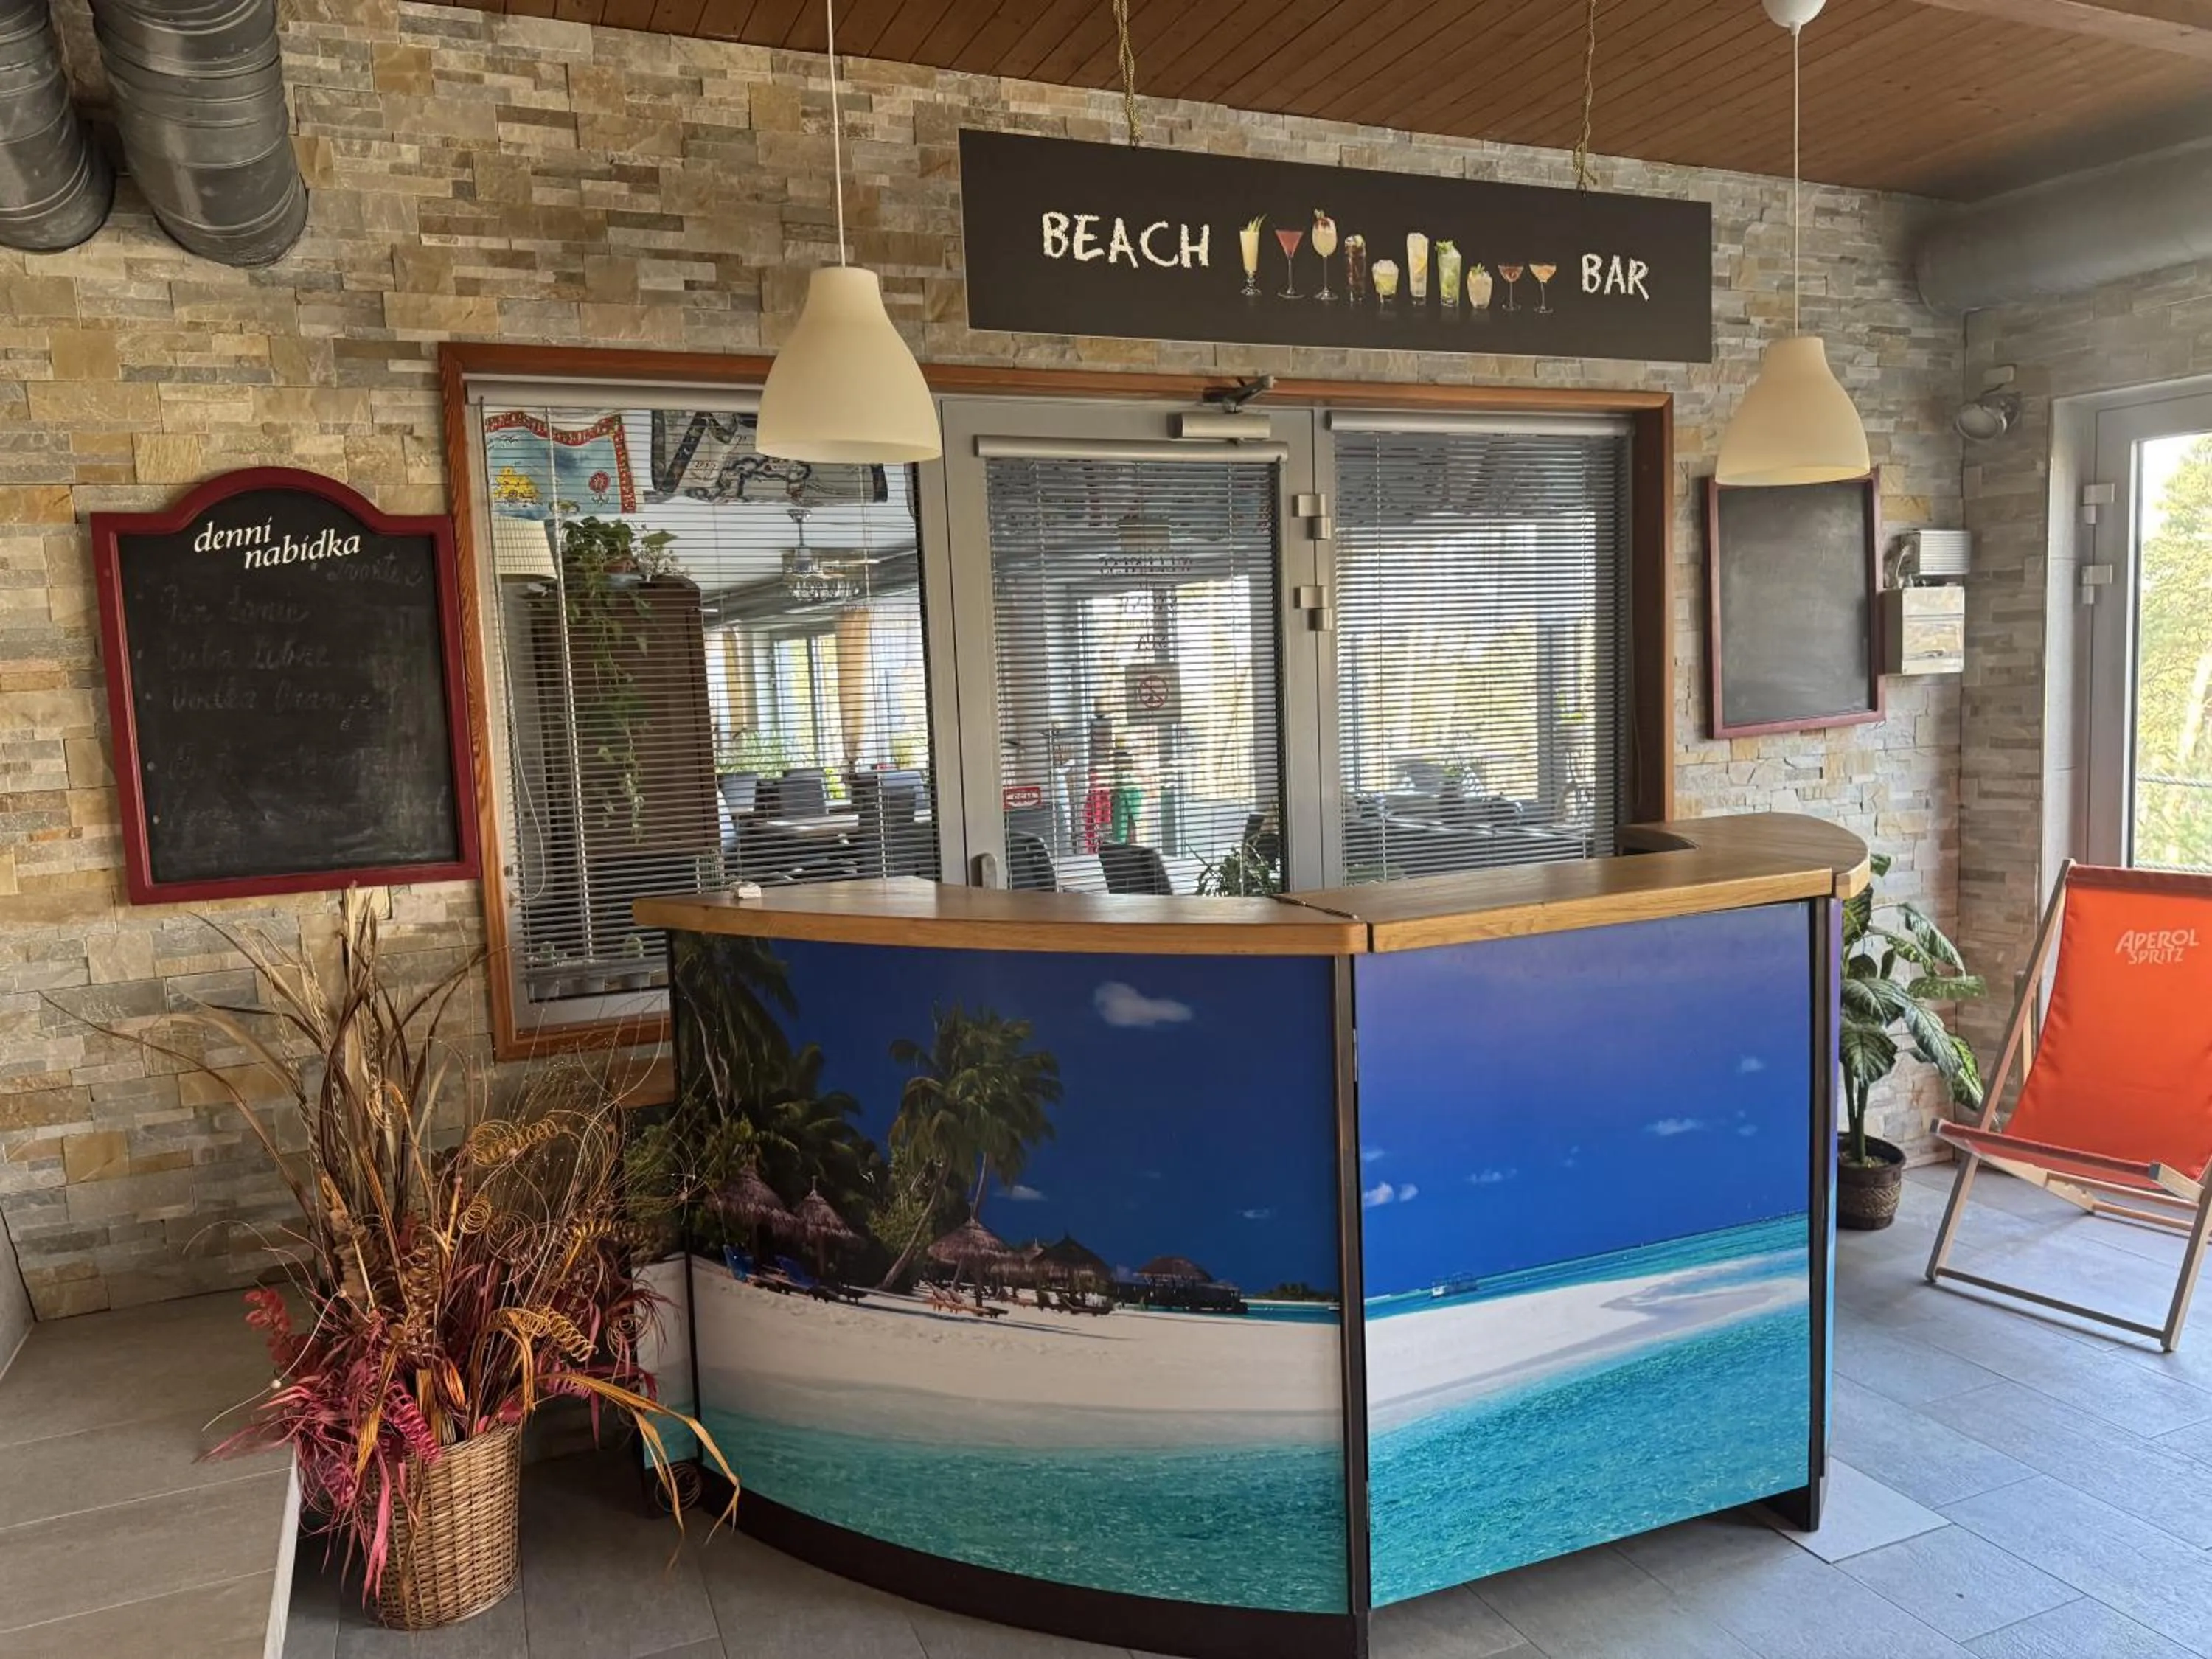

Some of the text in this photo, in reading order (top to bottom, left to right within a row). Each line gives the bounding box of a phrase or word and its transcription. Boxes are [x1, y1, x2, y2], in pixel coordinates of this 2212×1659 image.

[1043, 212, 1649, 301] BEACH BAR
[193, 516, 272, 553] denní
[244, 528, 361, 569] nabídka
[2115, 928, 2200, 955] APEROL
[2127, 947, 2184, 965] SPRITZ
